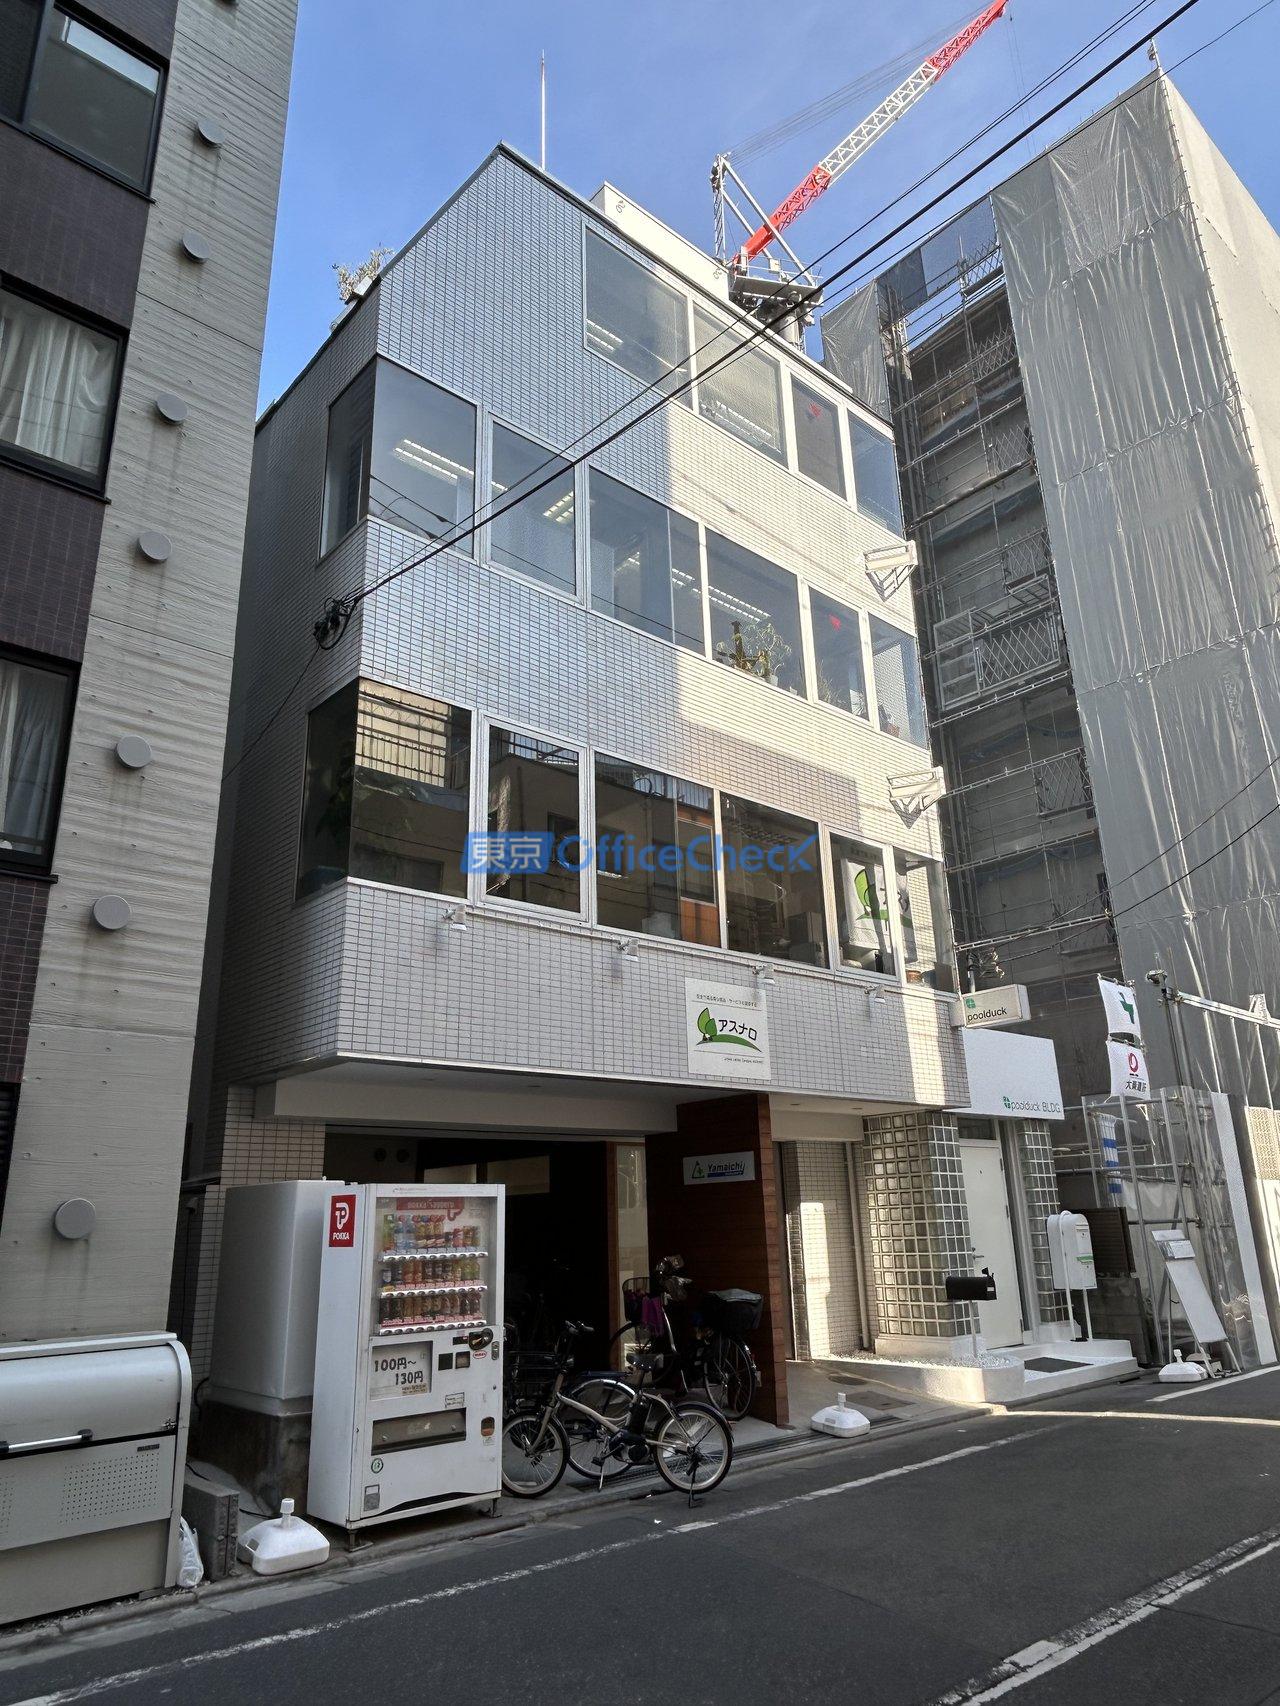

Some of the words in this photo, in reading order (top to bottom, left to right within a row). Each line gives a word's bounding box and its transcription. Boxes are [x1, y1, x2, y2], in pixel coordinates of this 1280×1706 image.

[967, 1007, 1007, 1023] poolduck
[718, 1019, 758, 1041] アスナロ
[1011, 1100, 1041, 1112] poolduck
[1042, 1101, 1061, 1113] BLDG
[332, 1231, 350, 1241] POKKA
[395, 1370, 424, 1386] 130円
